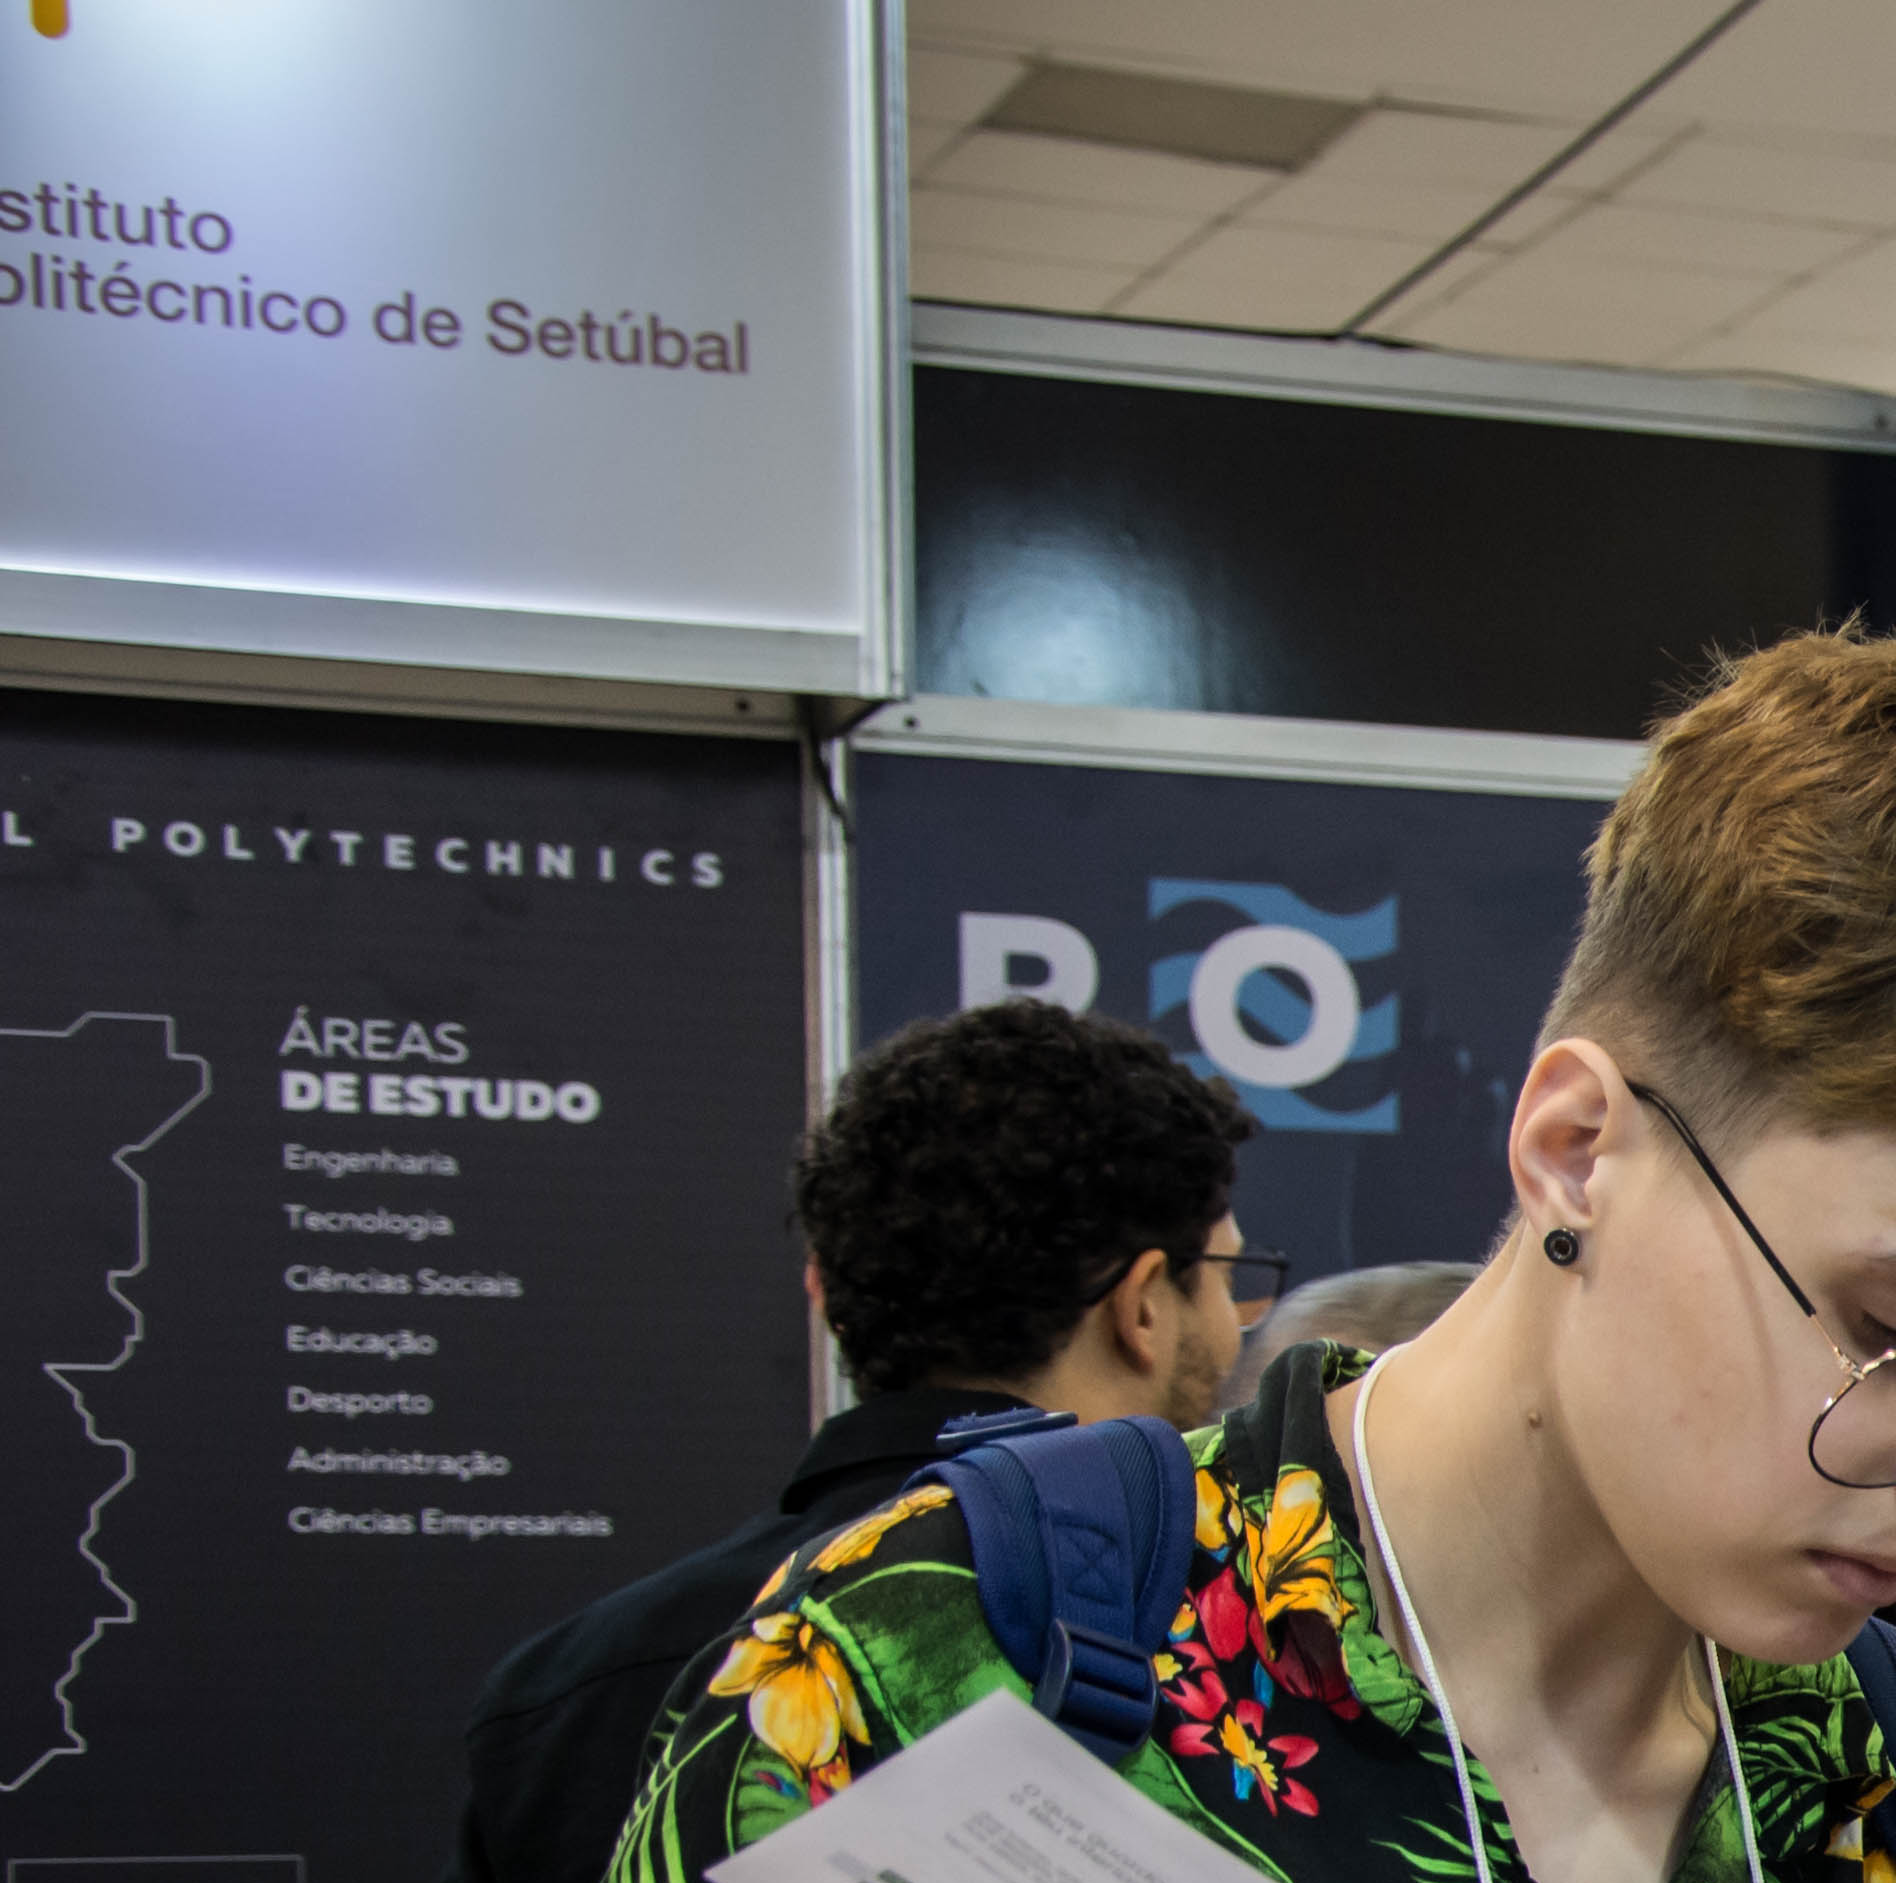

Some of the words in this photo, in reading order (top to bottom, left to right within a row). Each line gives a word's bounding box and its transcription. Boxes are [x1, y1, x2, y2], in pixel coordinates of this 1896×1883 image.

[0, 182, 234, 254] stituto
[373, 291, 462, 349] de
[486, 298, 750, 375] Setúbal
[112, 817, 724, 888] POLYTECHNICS
[280, 1006, 468, 1064] ÁREAS
[281, 1072, 358, 1114] DE
[369, 1074, 601, 1124] ESTUDO
[283, 1142, 459, 1178] Engenharia
[284, 1203, 454, 1241] Tecnologia
[285, 1264, 412, 1297] Ciências
[418, 1268, 523, 1299] Sociais
[287, 1324, 438, 1360] Educação
[288, 1386, 434, 1420] Desporto
[288, 1445, 511, 1482] Administração
[289, 1506, 413, 1539] Ciências
[421, 1508, 614, 1541] Empresariais
